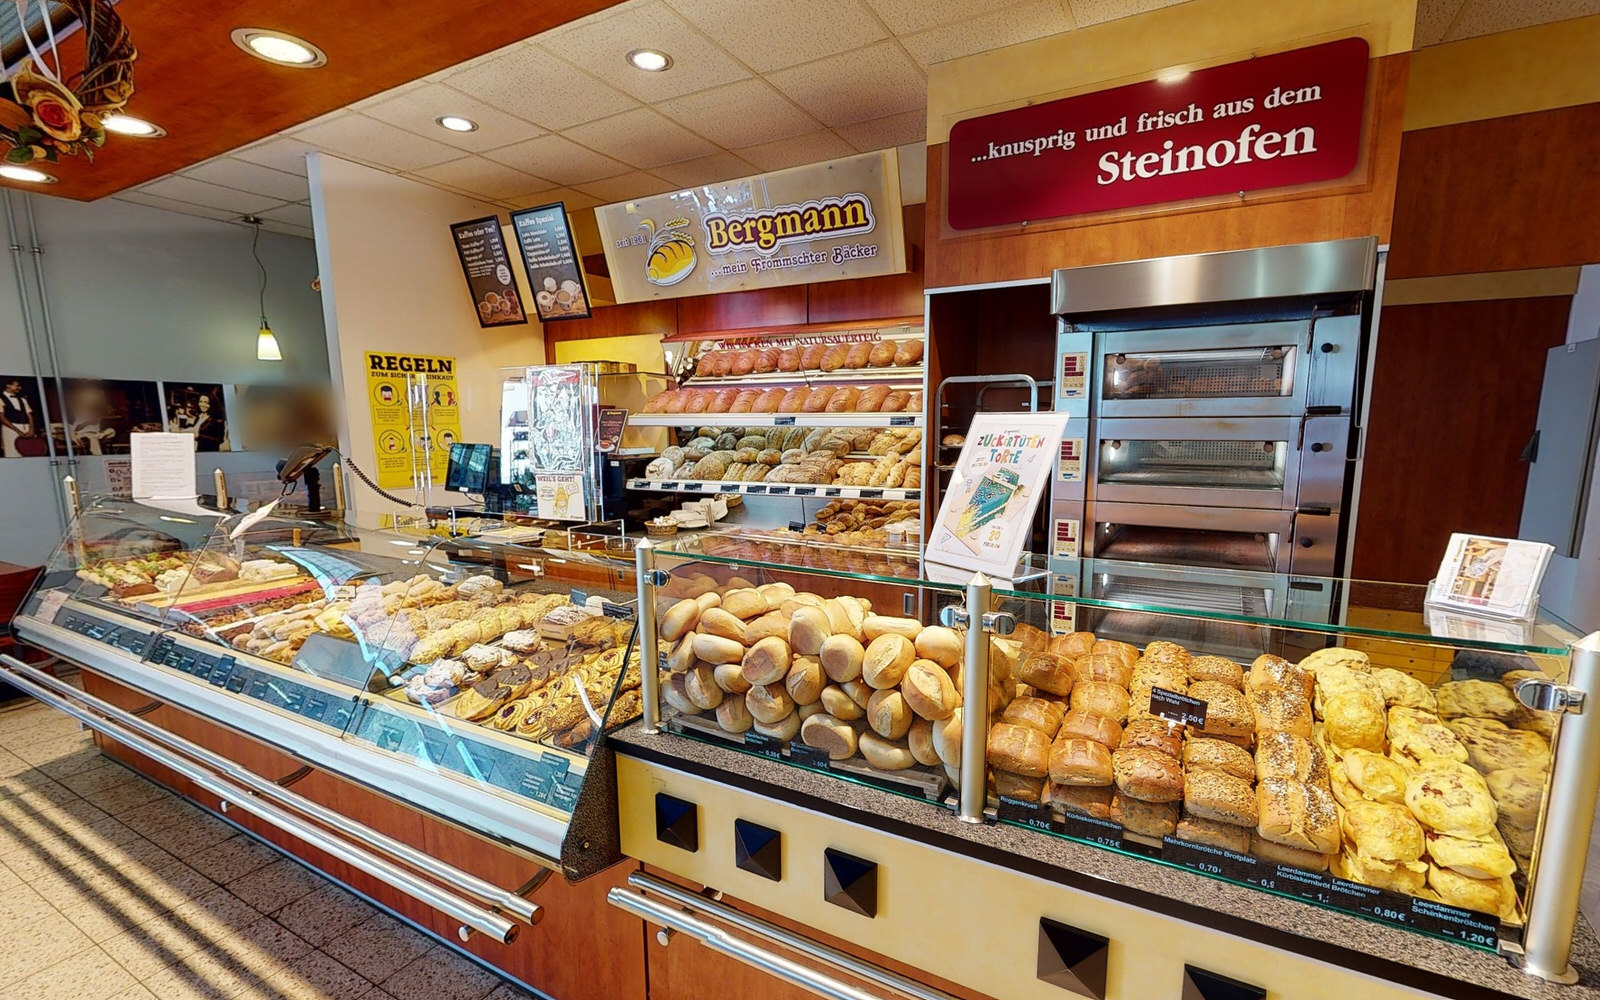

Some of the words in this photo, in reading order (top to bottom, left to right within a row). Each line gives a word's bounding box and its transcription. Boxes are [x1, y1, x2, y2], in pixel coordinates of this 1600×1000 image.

[970, 130, 1076, 163] ...knusprig
[1085, 117, 1128, 142] und
[1136, 104, 1204, 135] frisch
[1212, 96, 1255, 118] aus
[1263, 83, 1322, 110] dem
[1096, 124, 1317, 187] Steinofen
[705, 199, 869, 249] Bergmann
[616, 237, 630, 248] seit
[630, 234, 646, 246] 1961
[710, 262, 748, 277] ...mein
[750, 252, 827, 273] Frömmschter
[832, 244, 878, 265] Bäcker
[775, 337, 794, 347] MIT
[795, 332, 882, 346] NATURSAUERTEIG
[368, 354, 453, 373] REGELN
[977, 433, 1046, 449] ZUCKERTÜTEN
[989, 448, 1023, 464] TORTE
[989, 530, 1001, 541] 20
[1151, 693, 1166, 701] nach
[1165, 697, 1181, 706] Wahl
[1157, 689, 1201, 706] Spezialbrötchen
[1028, 818, 1051, 830] 0,70€
[1066, 811, 1123, 831] Kürbiskernbrötchen
[1097, 836, 1121, 849] 0,75€
[1163, 836, 1223, 856] Mehrkornbrötche
[1223, 850, 1257, 866] Brotplatz
[1277, 864, 1323, 881] Leerdammer
[1331, 884, 1367, 899] Brötchen
[1332, 878, 1381, 895] Leerdammer
[1373, 905, 1406, 922] 0,80€
[1412, 897, 1472, 919] Leerdammer
[1411, 904, 1497, 932] Schinkenbrötchen
[1460, 929, 1495, 946] 1,20€
